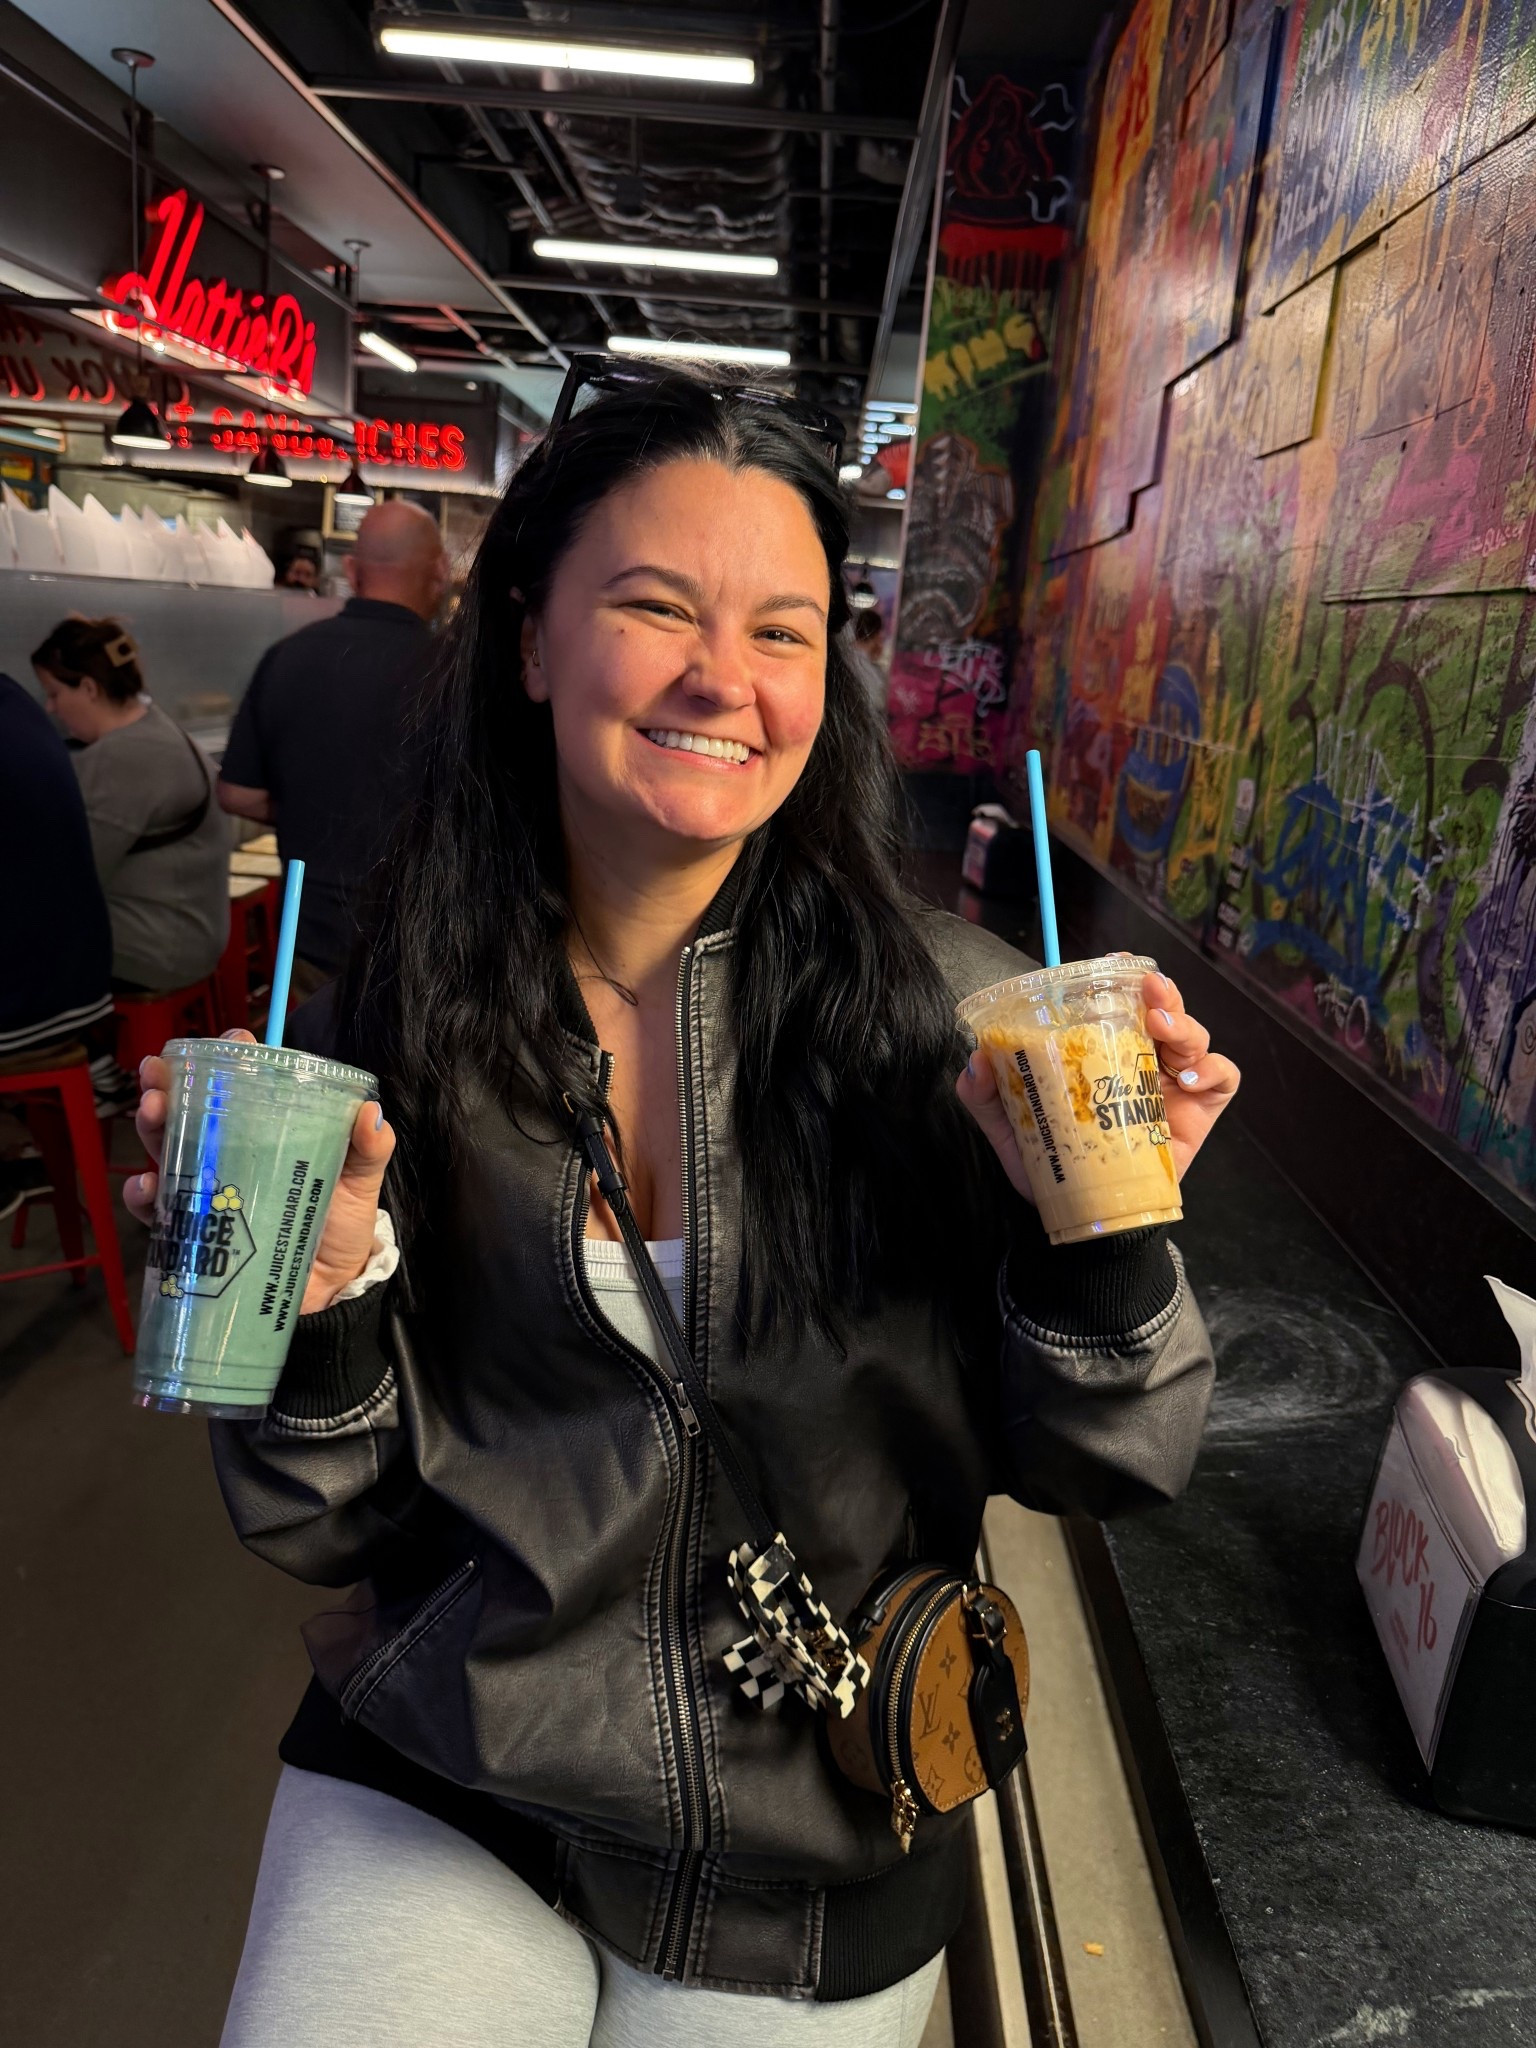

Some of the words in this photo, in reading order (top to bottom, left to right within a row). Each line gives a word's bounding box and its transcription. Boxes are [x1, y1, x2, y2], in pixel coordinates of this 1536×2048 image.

[1014, 1049, 1066, 1184] WWW.JUICESTANDARD.COM
[1093, 1074, 1133, 1104] The
[259, 1160, 310, 1316] WWW.JUICESTANDARD.COM
[273, 1178, 325, 1332] WWW.JUICESTANDARD.COM
[1417, 1580, 1438, 1654] 16
